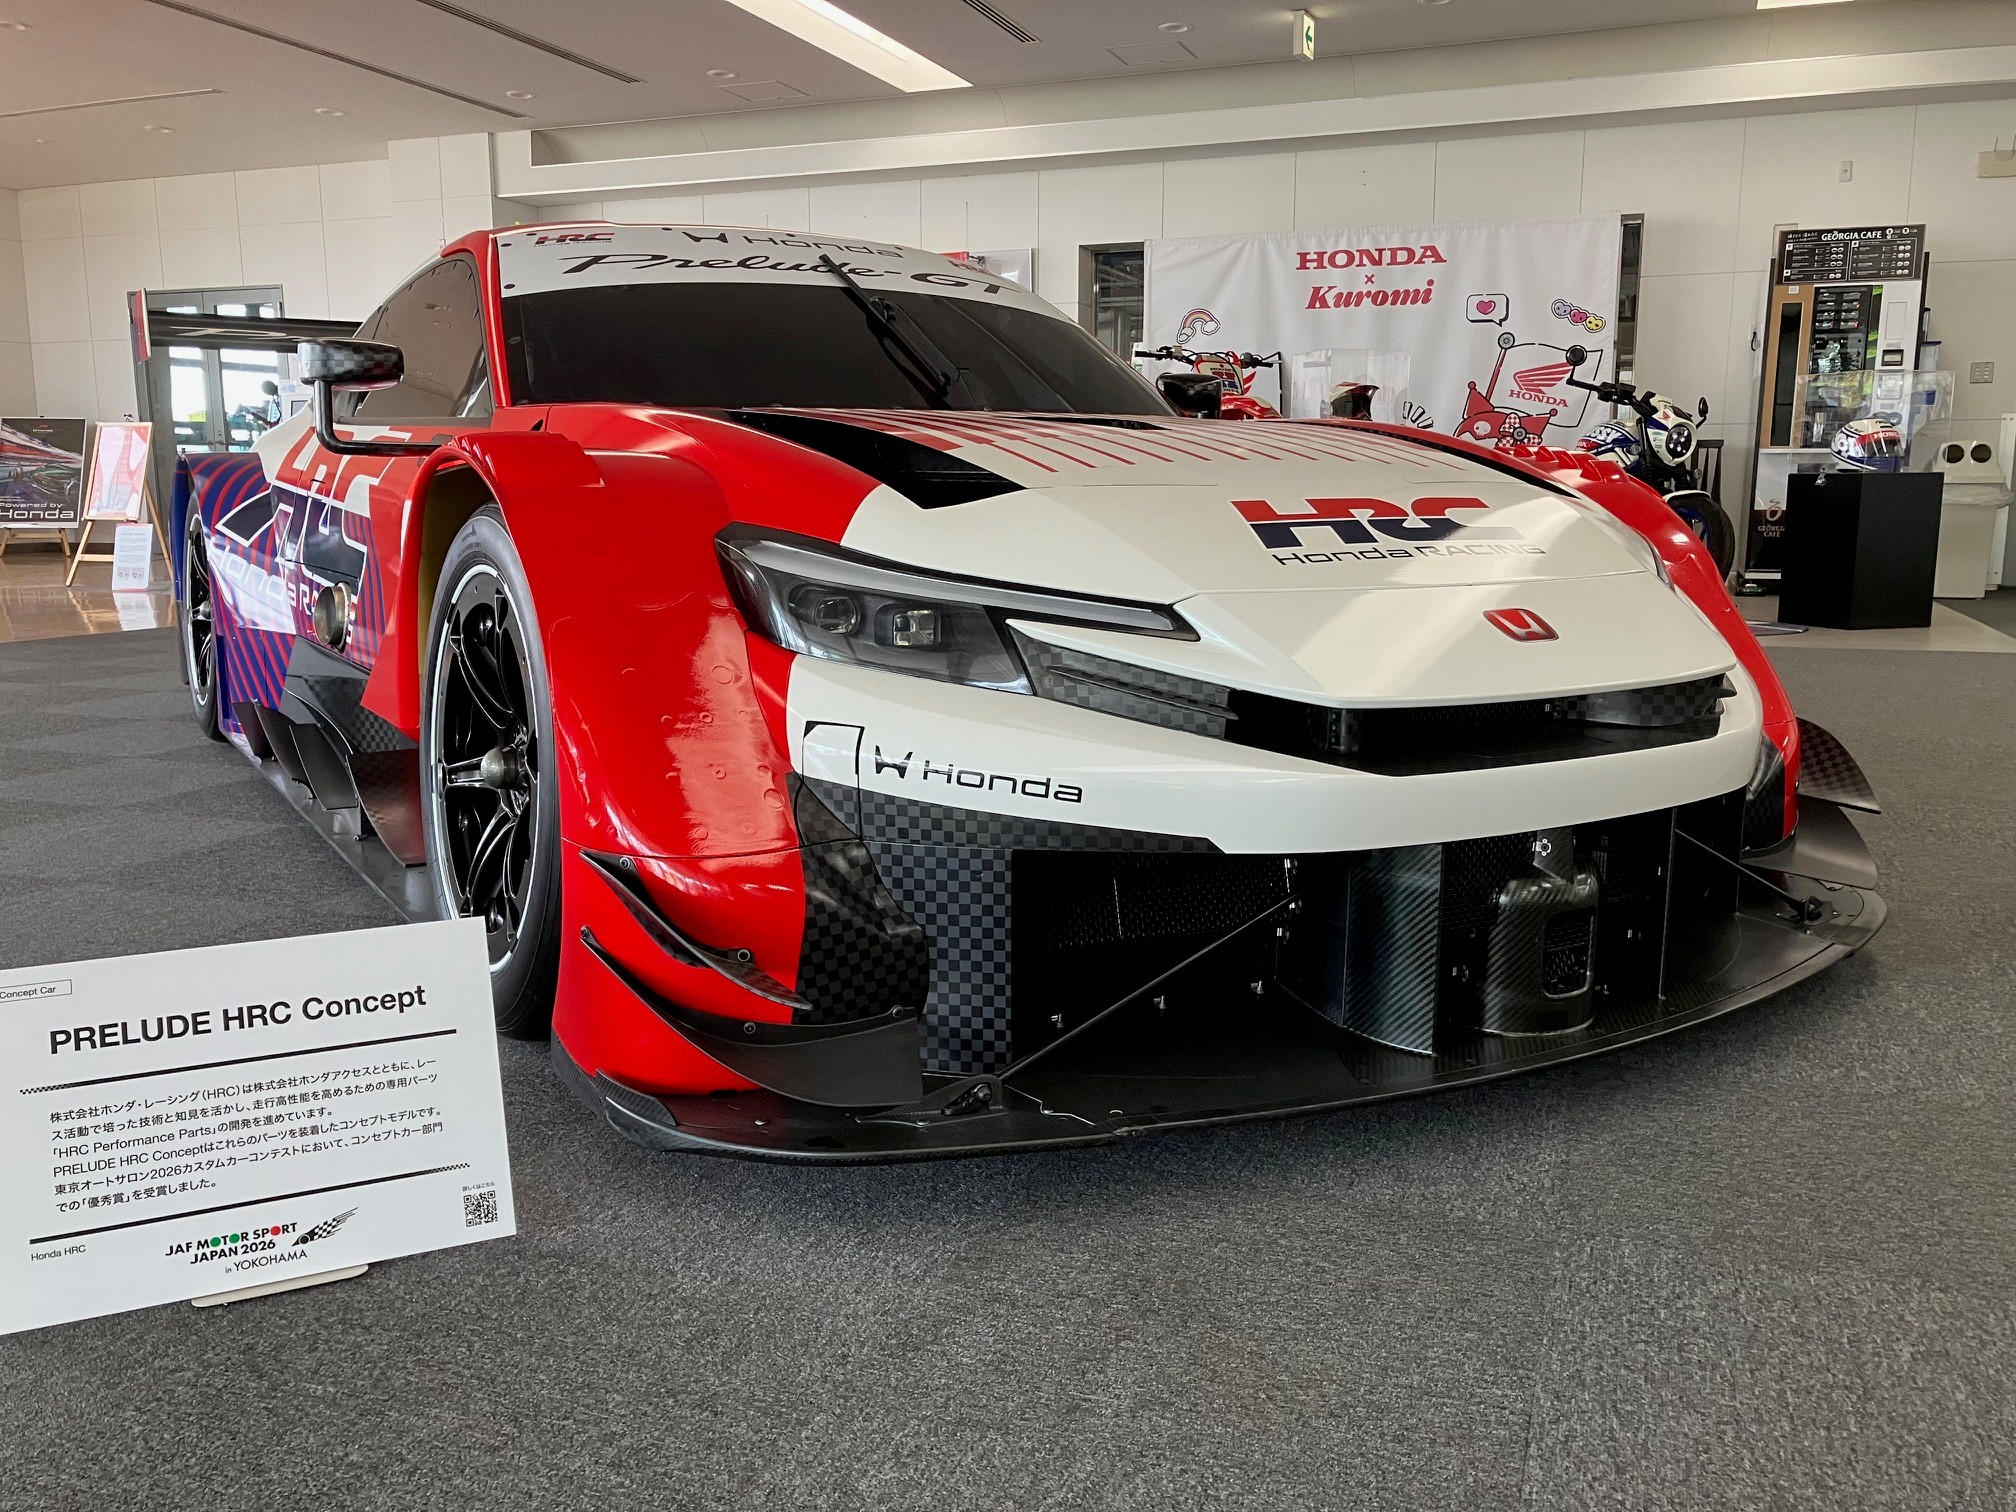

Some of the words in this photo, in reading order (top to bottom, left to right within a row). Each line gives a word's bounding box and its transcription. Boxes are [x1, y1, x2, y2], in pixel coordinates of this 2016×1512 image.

[534, 232, 615, 246] HRC
[741, 234, 904, 259] Honda
[1296, 245, 1447, 270] HONDA
[1305, 278, 1434, 309] Kuromi
[1509, 389, 1569, 408] HONDA
[0, 509, 74, 519] Honda
[52, 502, 65, 510] by
[1231, 497, 1525, 550] HRC
[922, 759, 1083, 803] Honda
[0, 987, 38, 999] Concept
[40, 985, 56, 995] Car
[50, 1011, 212, 1054] PRELUDE
[222, 1001, 292, 1031] HRC
[302, 986, 427, 1020] Concept
[93, 1132, 175, 1154] Performance
[54, 1158, 116, 1177] PRELUDE
[120, 1153, 149, 1167] HRC
[31, 1250, 62, 1261] Honda
[64, 1244, 86, 1255] HRC
[165, 1242, 193, 1257] JAF
[190, 1247, 238, 1265] JAPAN
[241, 1239, 276, 1256] 2026
[225, 1266, 232, 1274] in
[234, 1249, 308, 1272] YOKOHAMA
